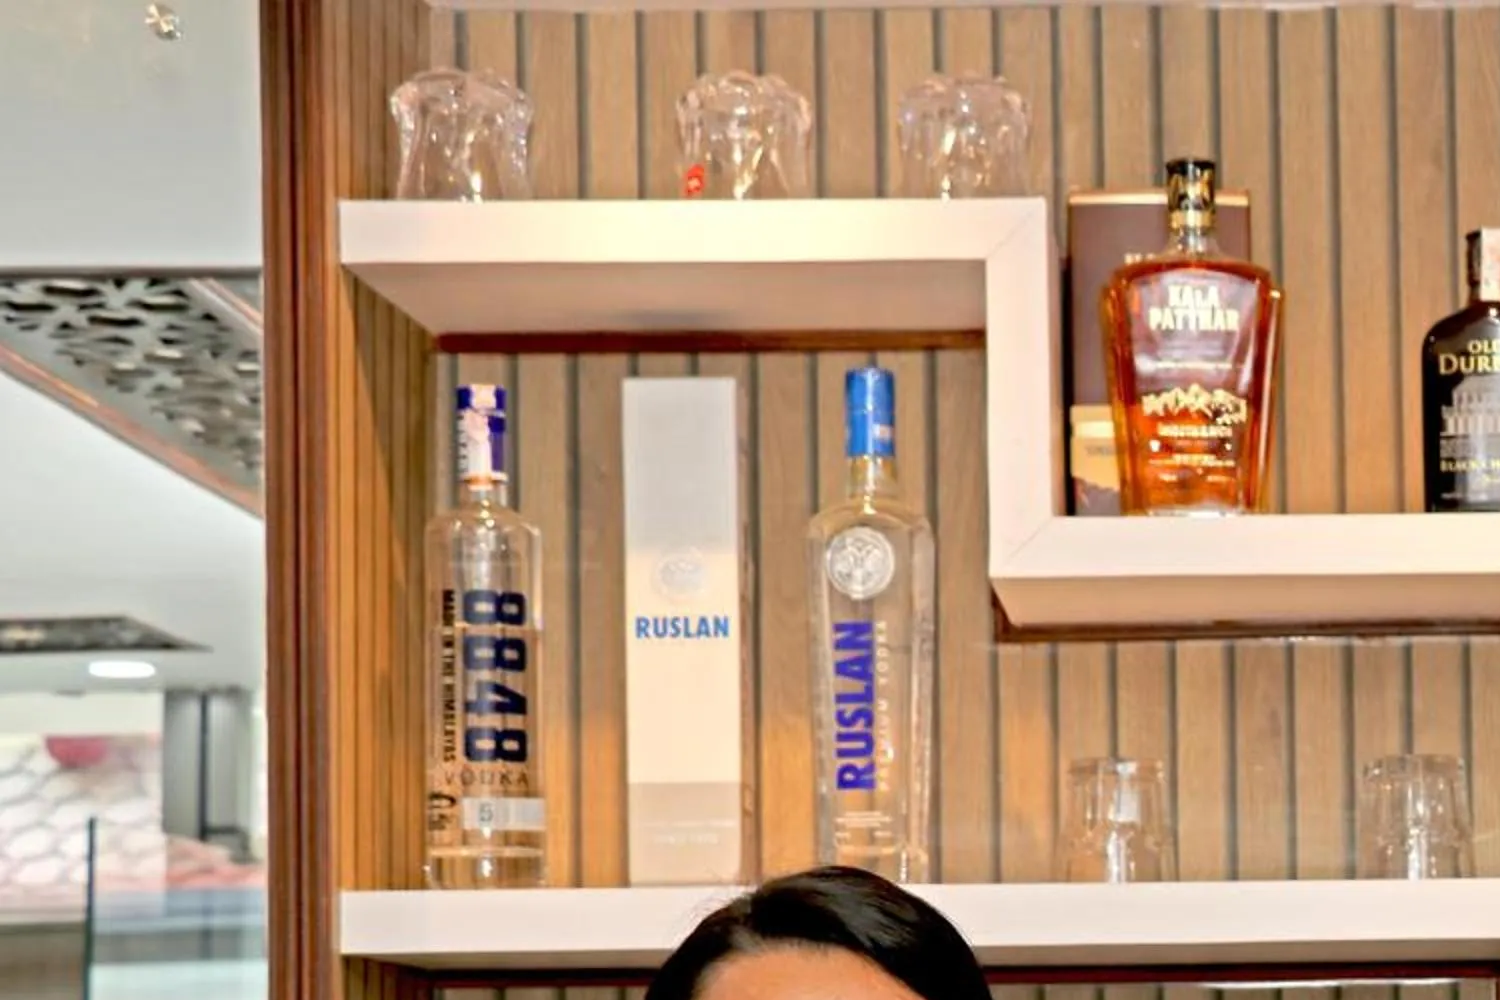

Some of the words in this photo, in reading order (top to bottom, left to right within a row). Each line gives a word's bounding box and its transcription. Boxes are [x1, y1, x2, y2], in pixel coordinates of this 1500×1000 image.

[463, 589, 528, 763] 8848
[635, 615, 730, 639] RUSLAN
[833, 620, 876, 790] RUSLAN
